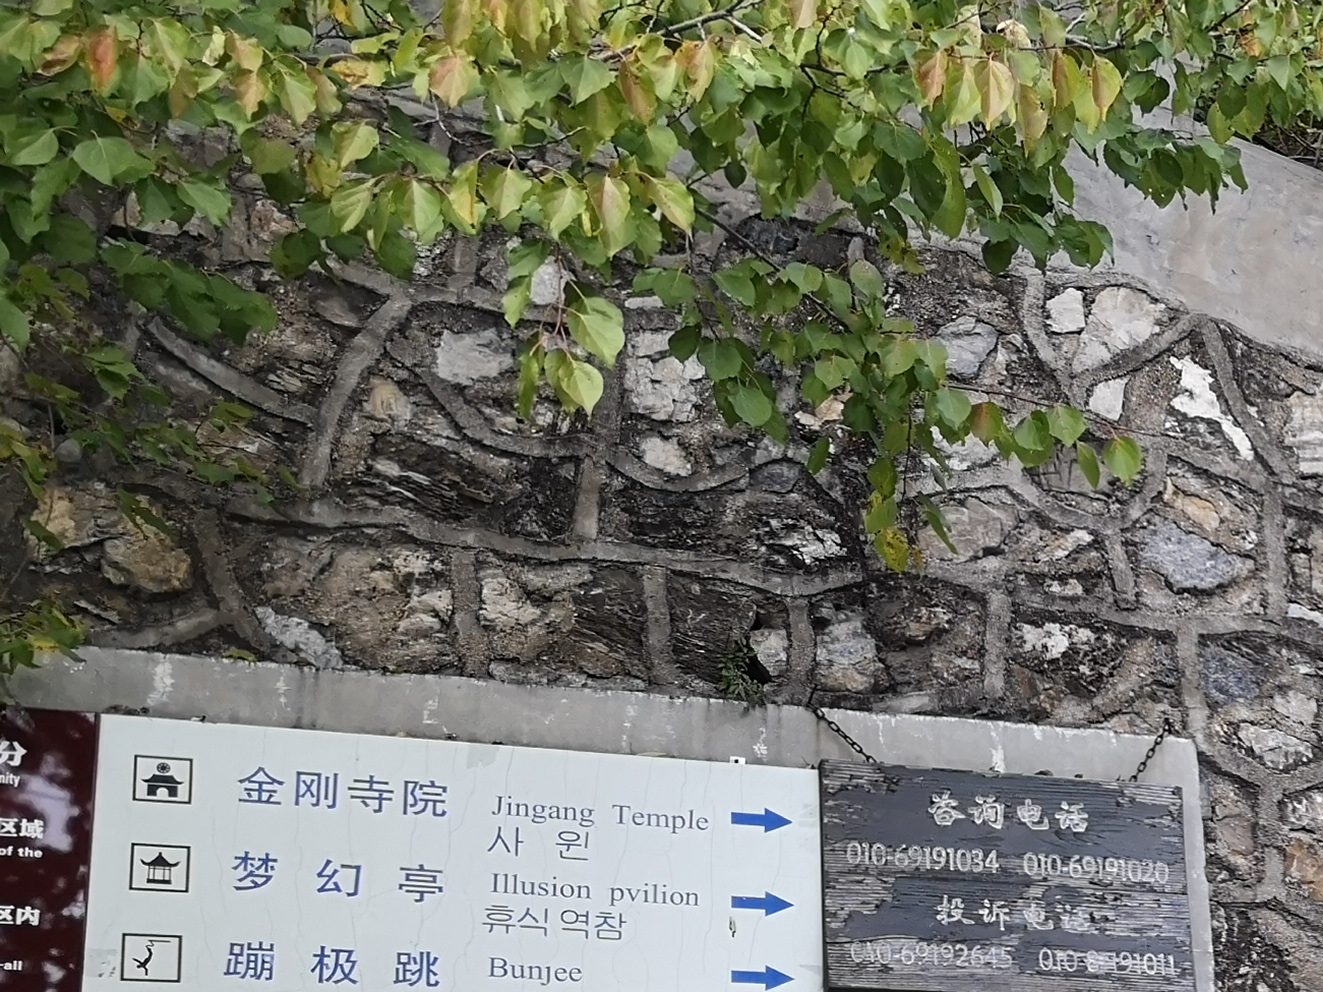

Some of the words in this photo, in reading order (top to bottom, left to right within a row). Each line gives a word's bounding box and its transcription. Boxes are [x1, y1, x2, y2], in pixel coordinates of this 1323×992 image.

[238, 766, 448, 817] 金刚寺院
[928, 789, 1089, 832] 咨询电话
[491, 795, 595, 828] Jingang
[611, 804, 710, 834] Temple
[18, 847, 43, 858] the
[846, 842, 1000, 874] 010-69191034
[1022, 851, 1170, 884] 010-69191020
[232, 850, 444, 903] 梦幻亭
[490, 872, 592, 900] Illusion
[609, 883, 700, 907] pvilion
[482, 904, 550, 937] 휴식
[223, 941, 441, 988] 蹦极跳
[488, 956, 583, 987] Bunjee
